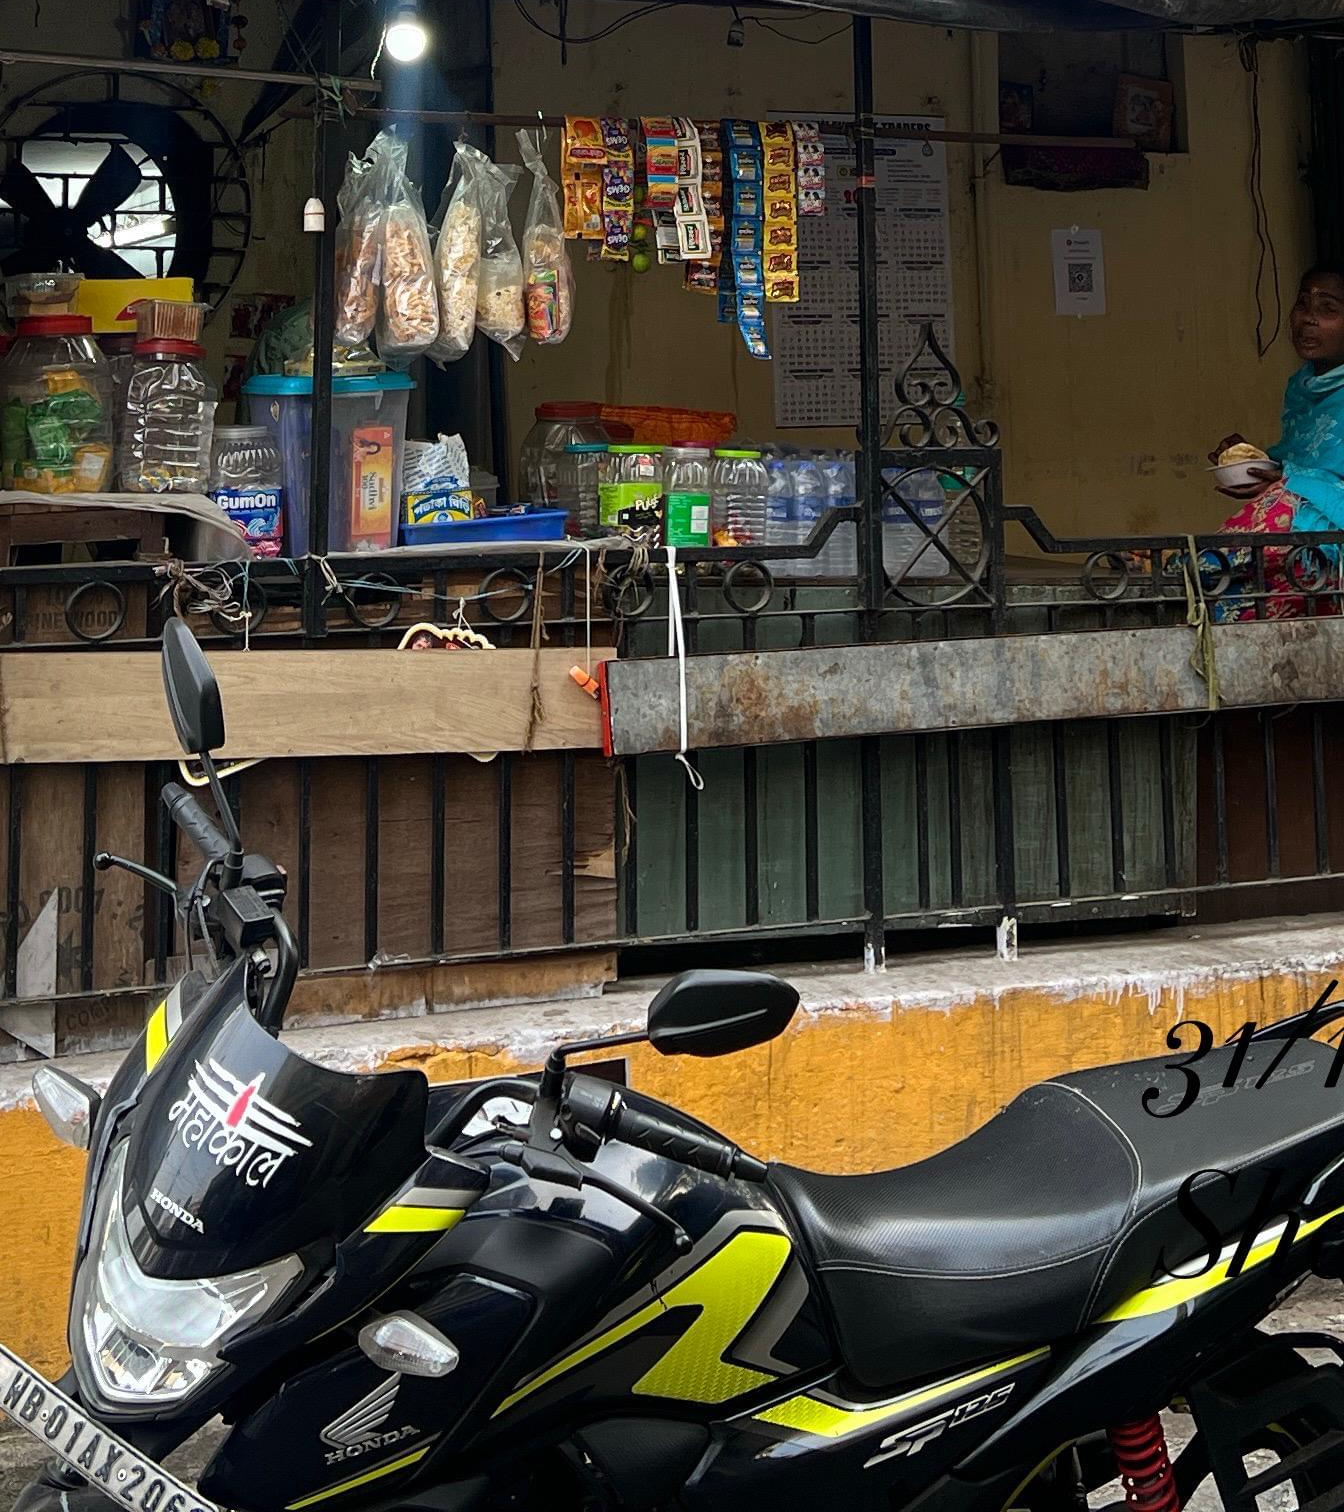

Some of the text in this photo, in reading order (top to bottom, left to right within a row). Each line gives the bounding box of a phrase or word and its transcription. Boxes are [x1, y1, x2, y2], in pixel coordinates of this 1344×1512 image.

[216, 492, 277, 511] GumOn
[150, 1188, 206, 1236] HONDA
[325, 1423, 421, 1467] HONDA
